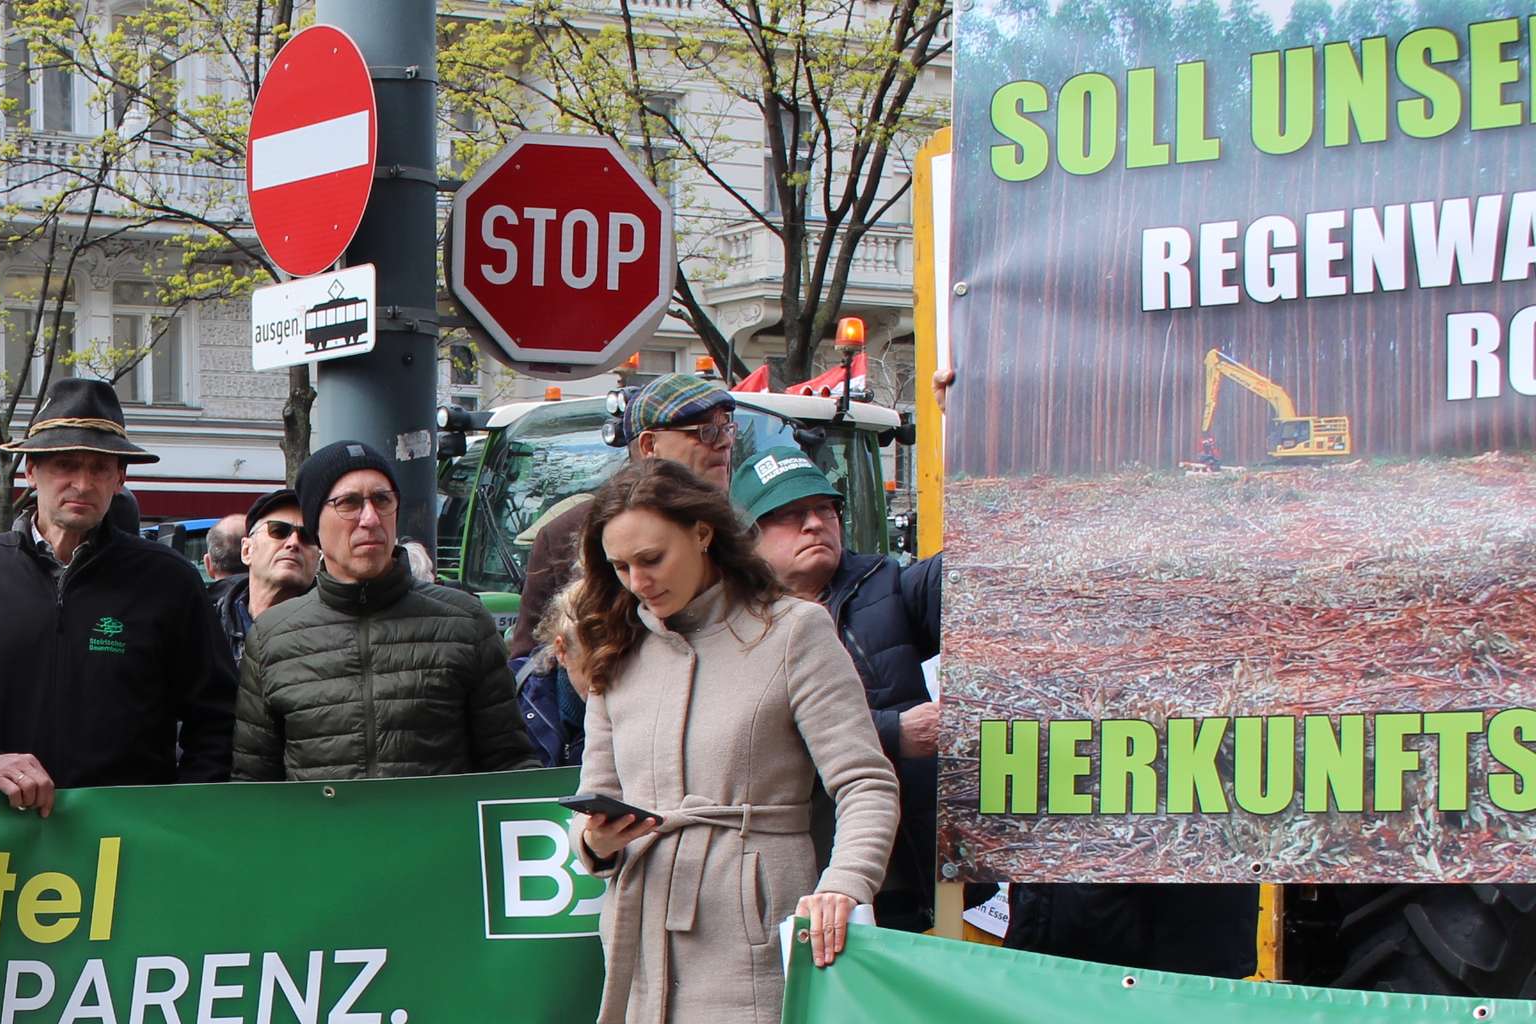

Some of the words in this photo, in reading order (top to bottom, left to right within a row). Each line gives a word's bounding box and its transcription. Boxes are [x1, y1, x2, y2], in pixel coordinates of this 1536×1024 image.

[990, 61, 1221, 182] SOLL
[1251, 14, 1536, 155] UNSE
[481, 205, 645, 291] STOP
[255, 316, 303, 345] ausgen.
[979, 708, 1536, 815] HERKUNFTS
